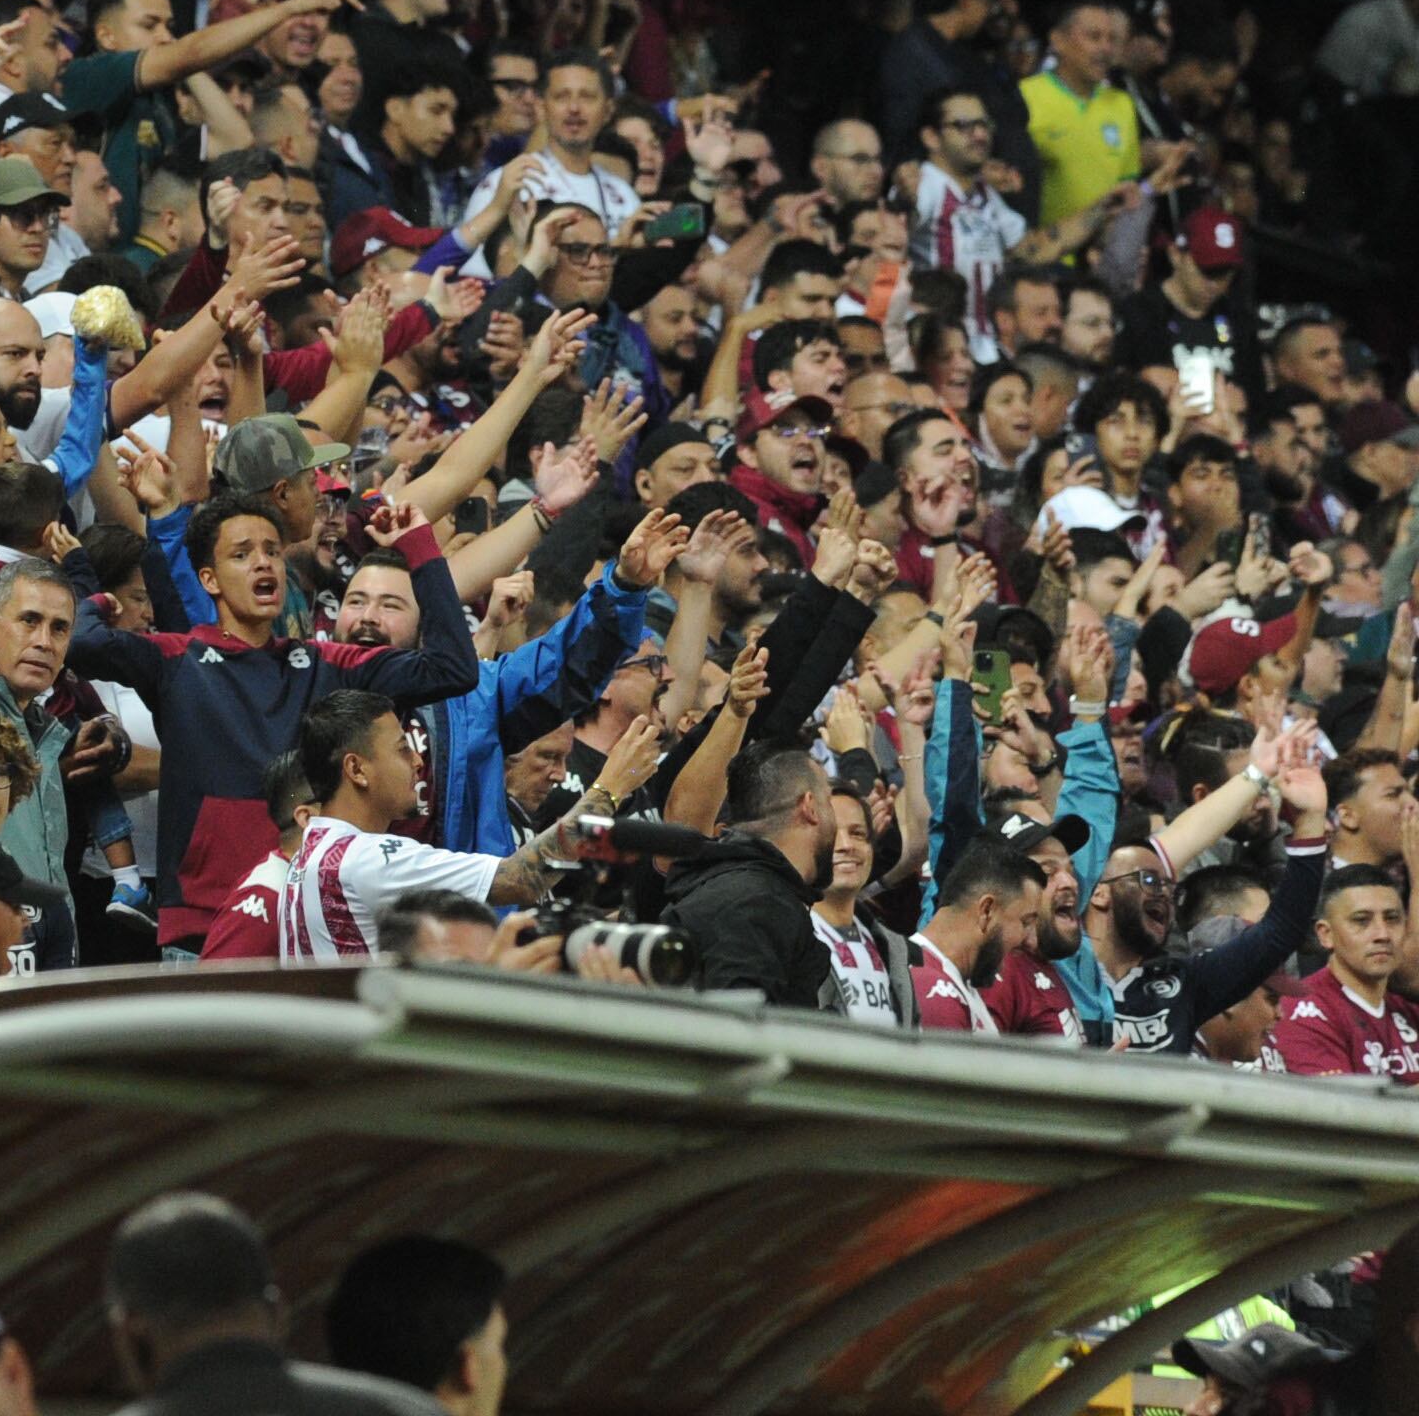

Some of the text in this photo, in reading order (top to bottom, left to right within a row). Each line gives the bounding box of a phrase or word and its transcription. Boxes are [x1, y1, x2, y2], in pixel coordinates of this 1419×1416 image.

[1214, 222, 1235, 249] S
[1230, 618, 1261, 637] S
[288, 647, 312, 669] S
[1392, 1012, 1418, 1043] S
